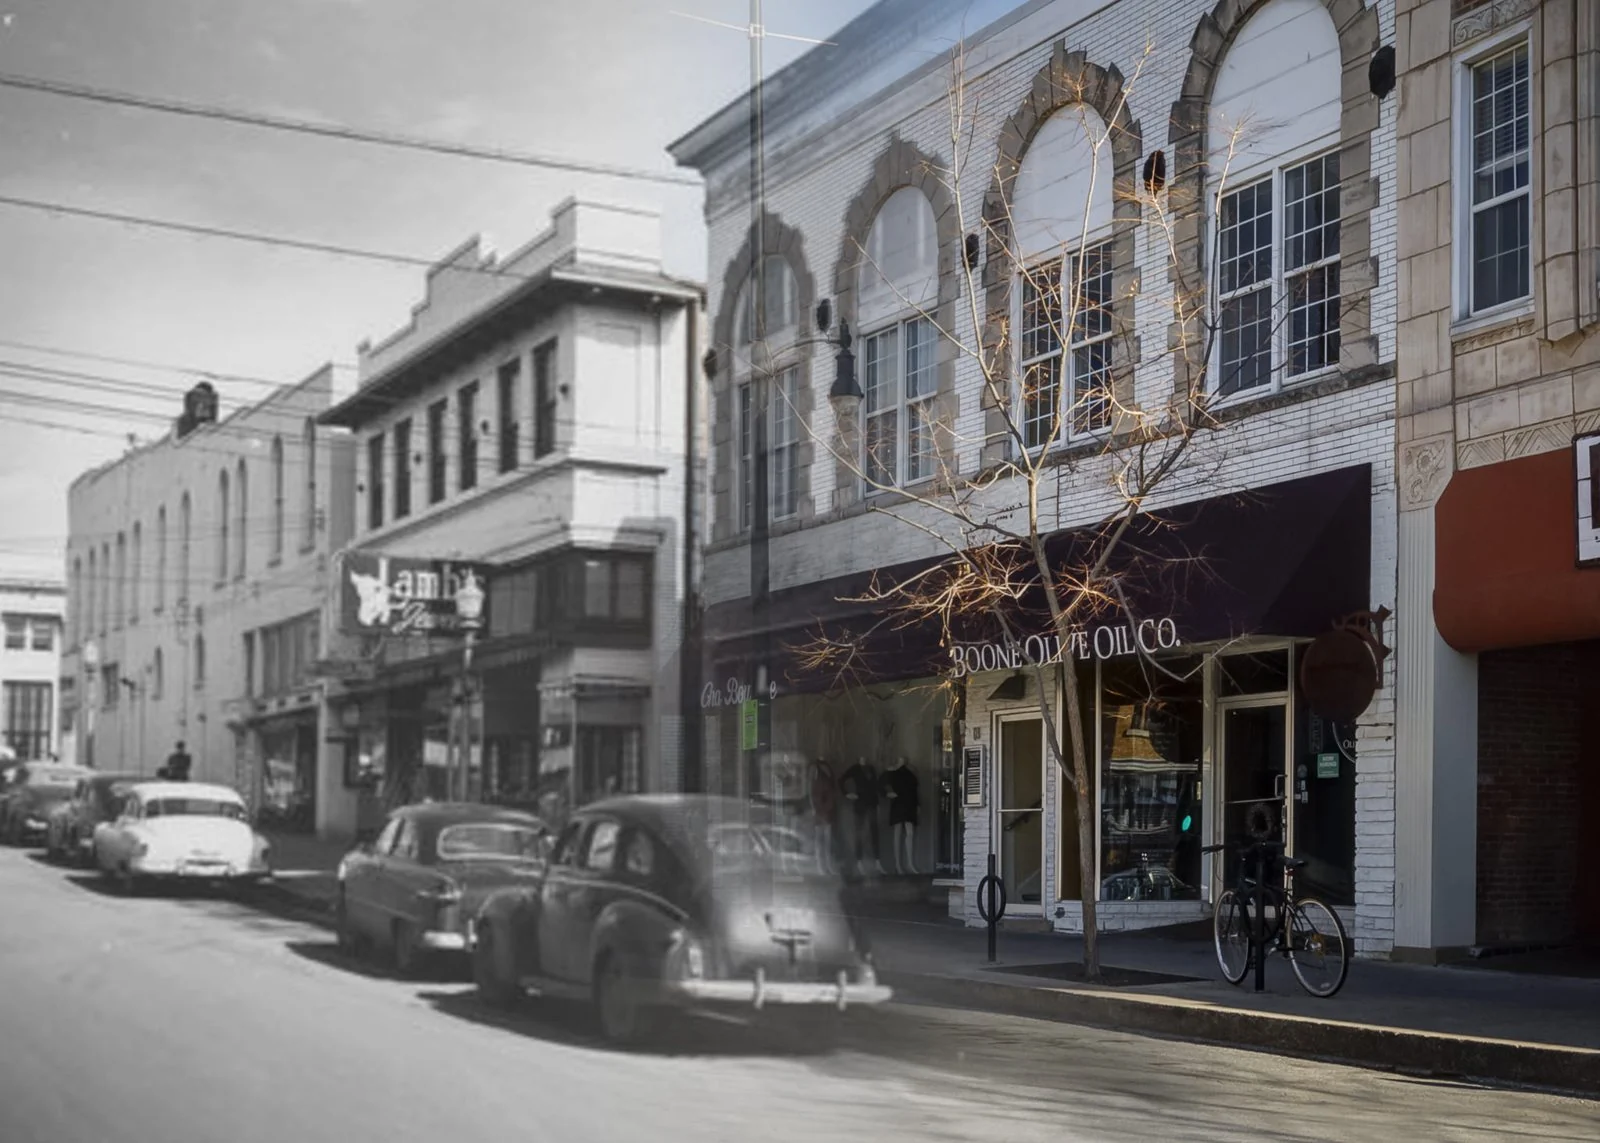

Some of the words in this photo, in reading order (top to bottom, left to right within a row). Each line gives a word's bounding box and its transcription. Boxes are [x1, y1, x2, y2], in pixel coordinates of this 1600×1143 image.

[951, 641, 1022, 678] BOONE
[1093, 625, 1136, 660] OIL
[1137, 617, 1181, 654] CO.
